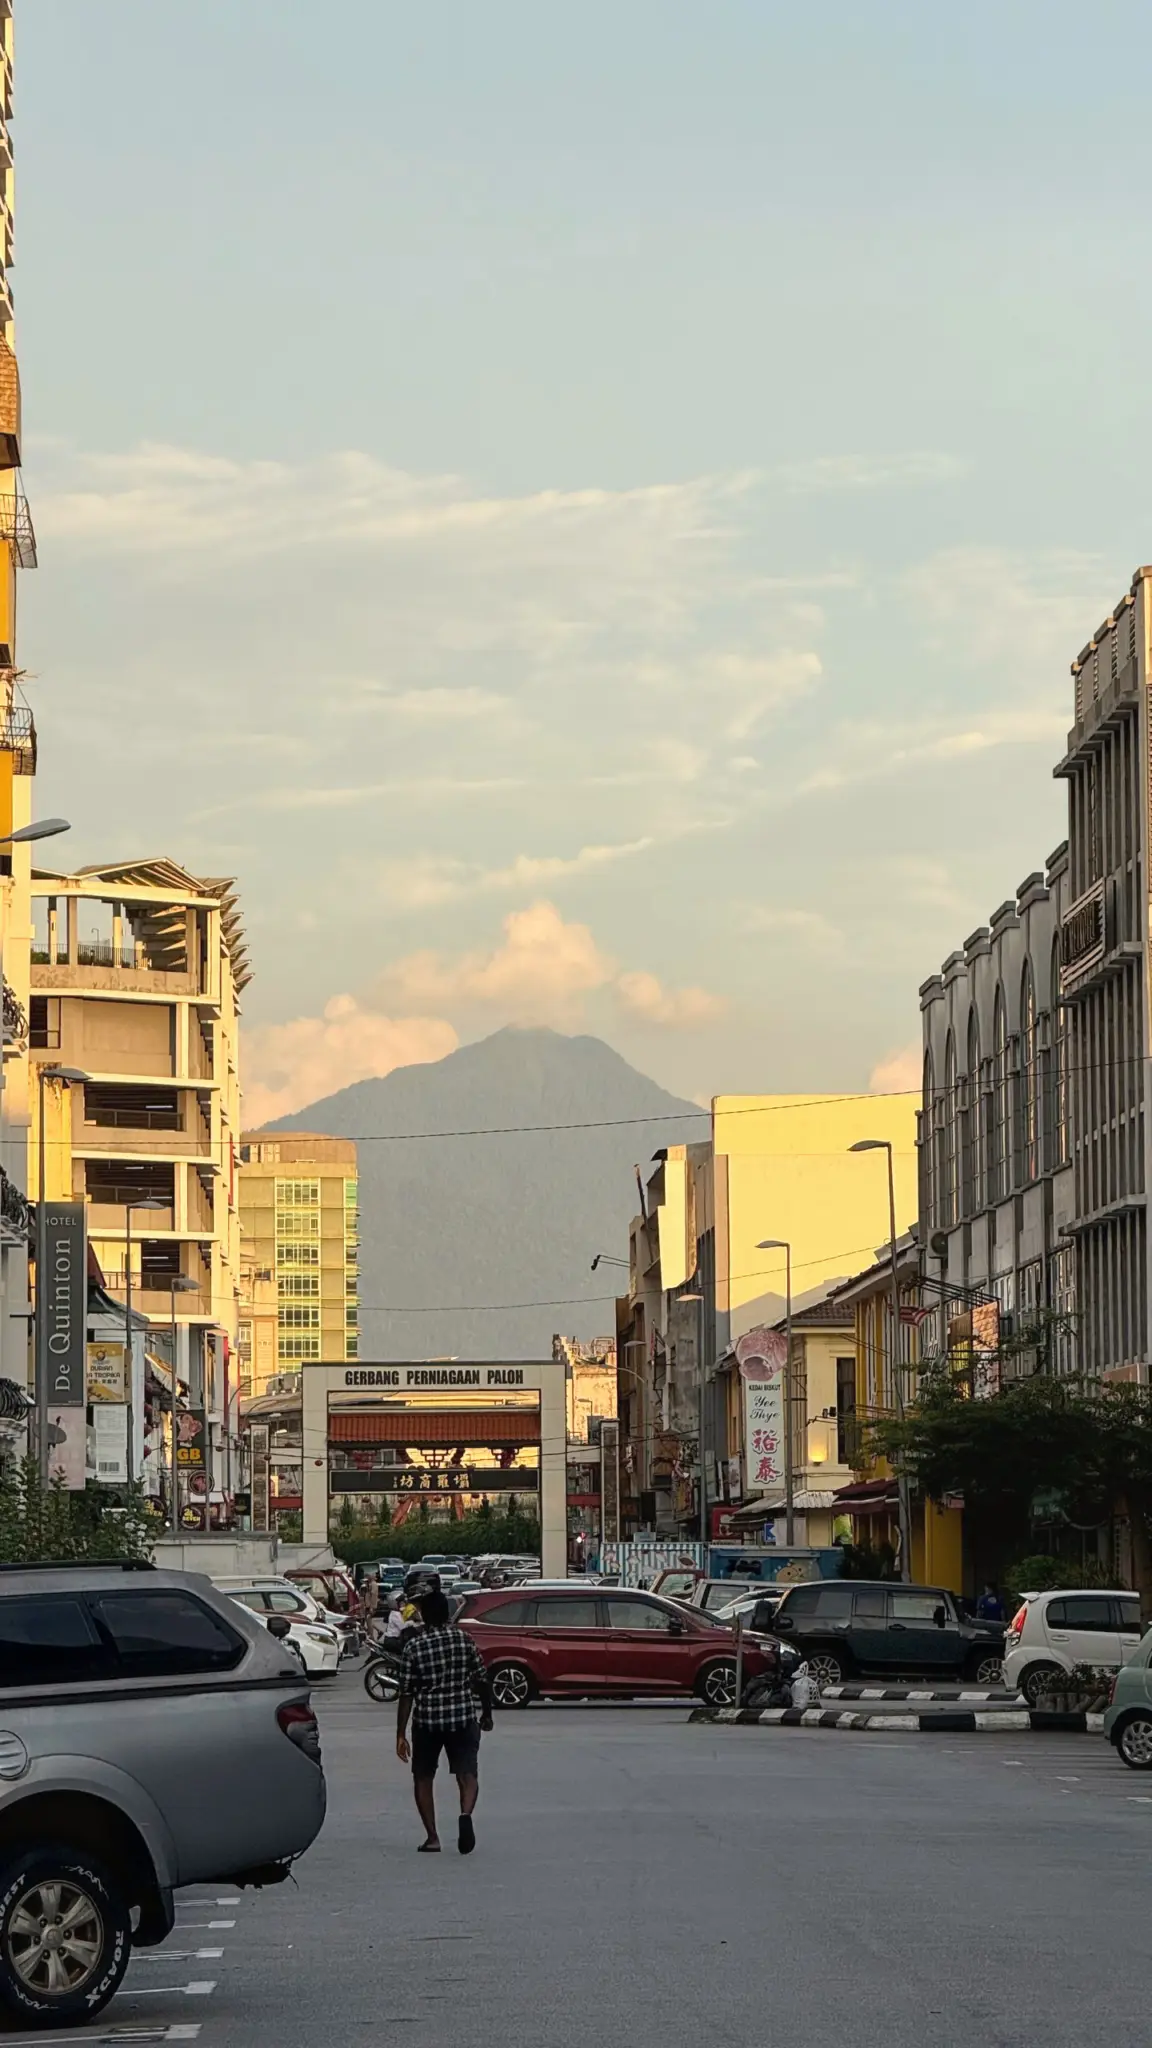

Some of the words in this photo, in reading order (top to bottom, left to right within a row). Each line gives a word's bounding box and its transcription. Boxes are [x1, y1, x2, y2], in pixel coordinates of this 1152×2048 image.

[48, 1239, 71, 1354] Quinton
[55, 1363, 71, 1391] De
[345, 1370, 399, 1386] GERBANG
[406, 1369, 480, 1385] PERNIAGAAN
[487, 1369, 524, 1385] PALOH
[753, 1395, 775, 1407] Yee
[749, 1408, 780, 1423] Thye
[177, 1448, 200, 1460] GB
[752, 1429, 783, 1484] 裕泰
[85, 1930, 124, 2008] ROADX
